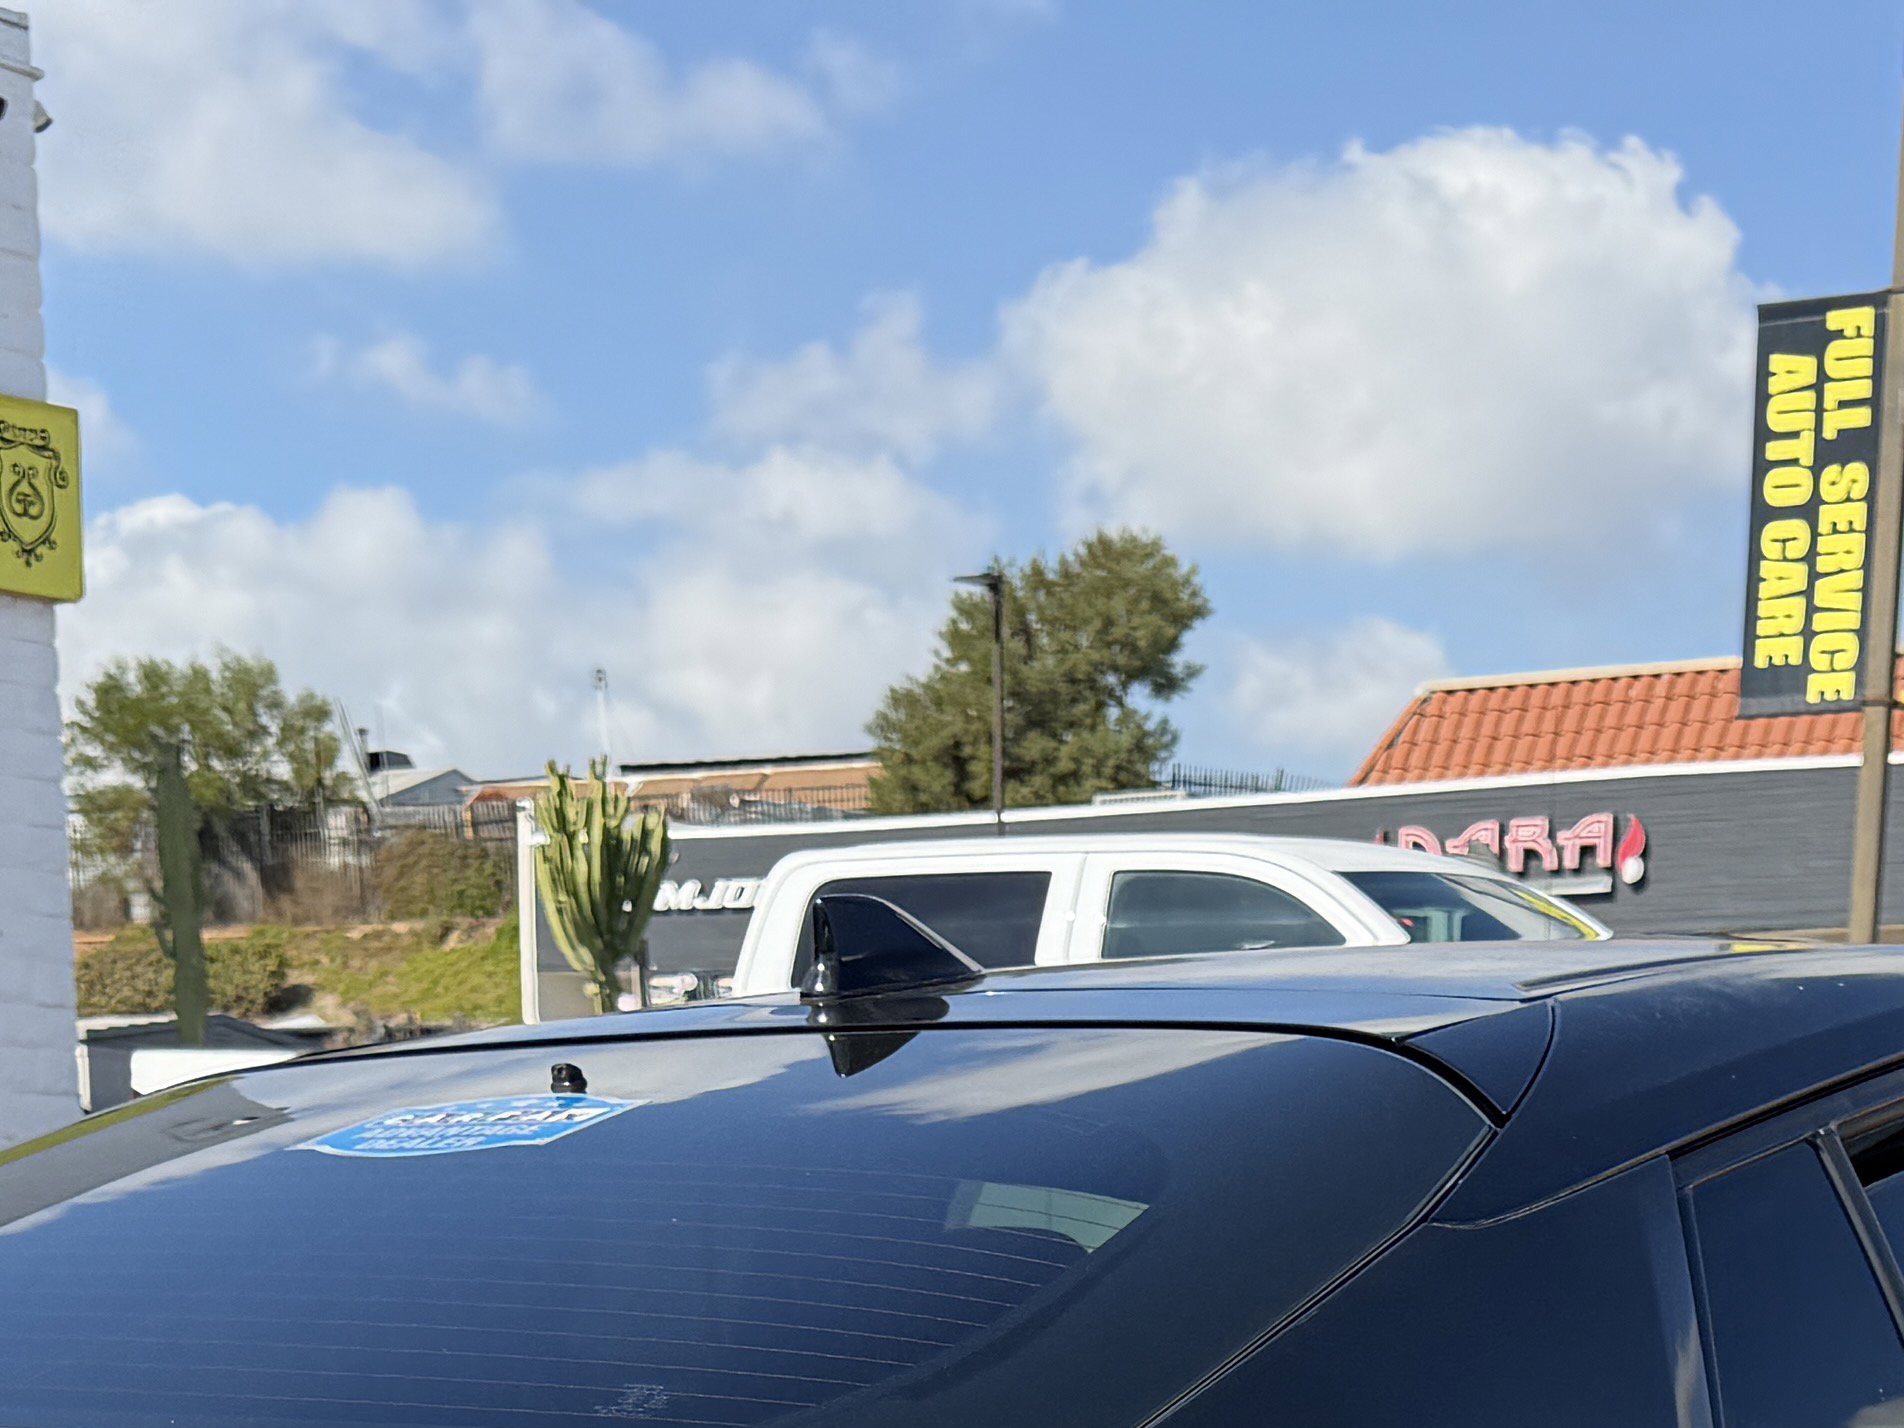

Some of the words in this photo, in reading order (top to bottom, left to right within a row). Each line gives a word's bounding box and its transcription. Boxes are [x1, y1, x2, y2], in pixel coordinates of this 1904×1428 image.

[1763, 353, 1818, 508] AUTO
[1822, 306, 1875, 441] FULL
[1754, 519, 1812, 669] CARE
[1806, 461, 1870, 704] SERVICE
